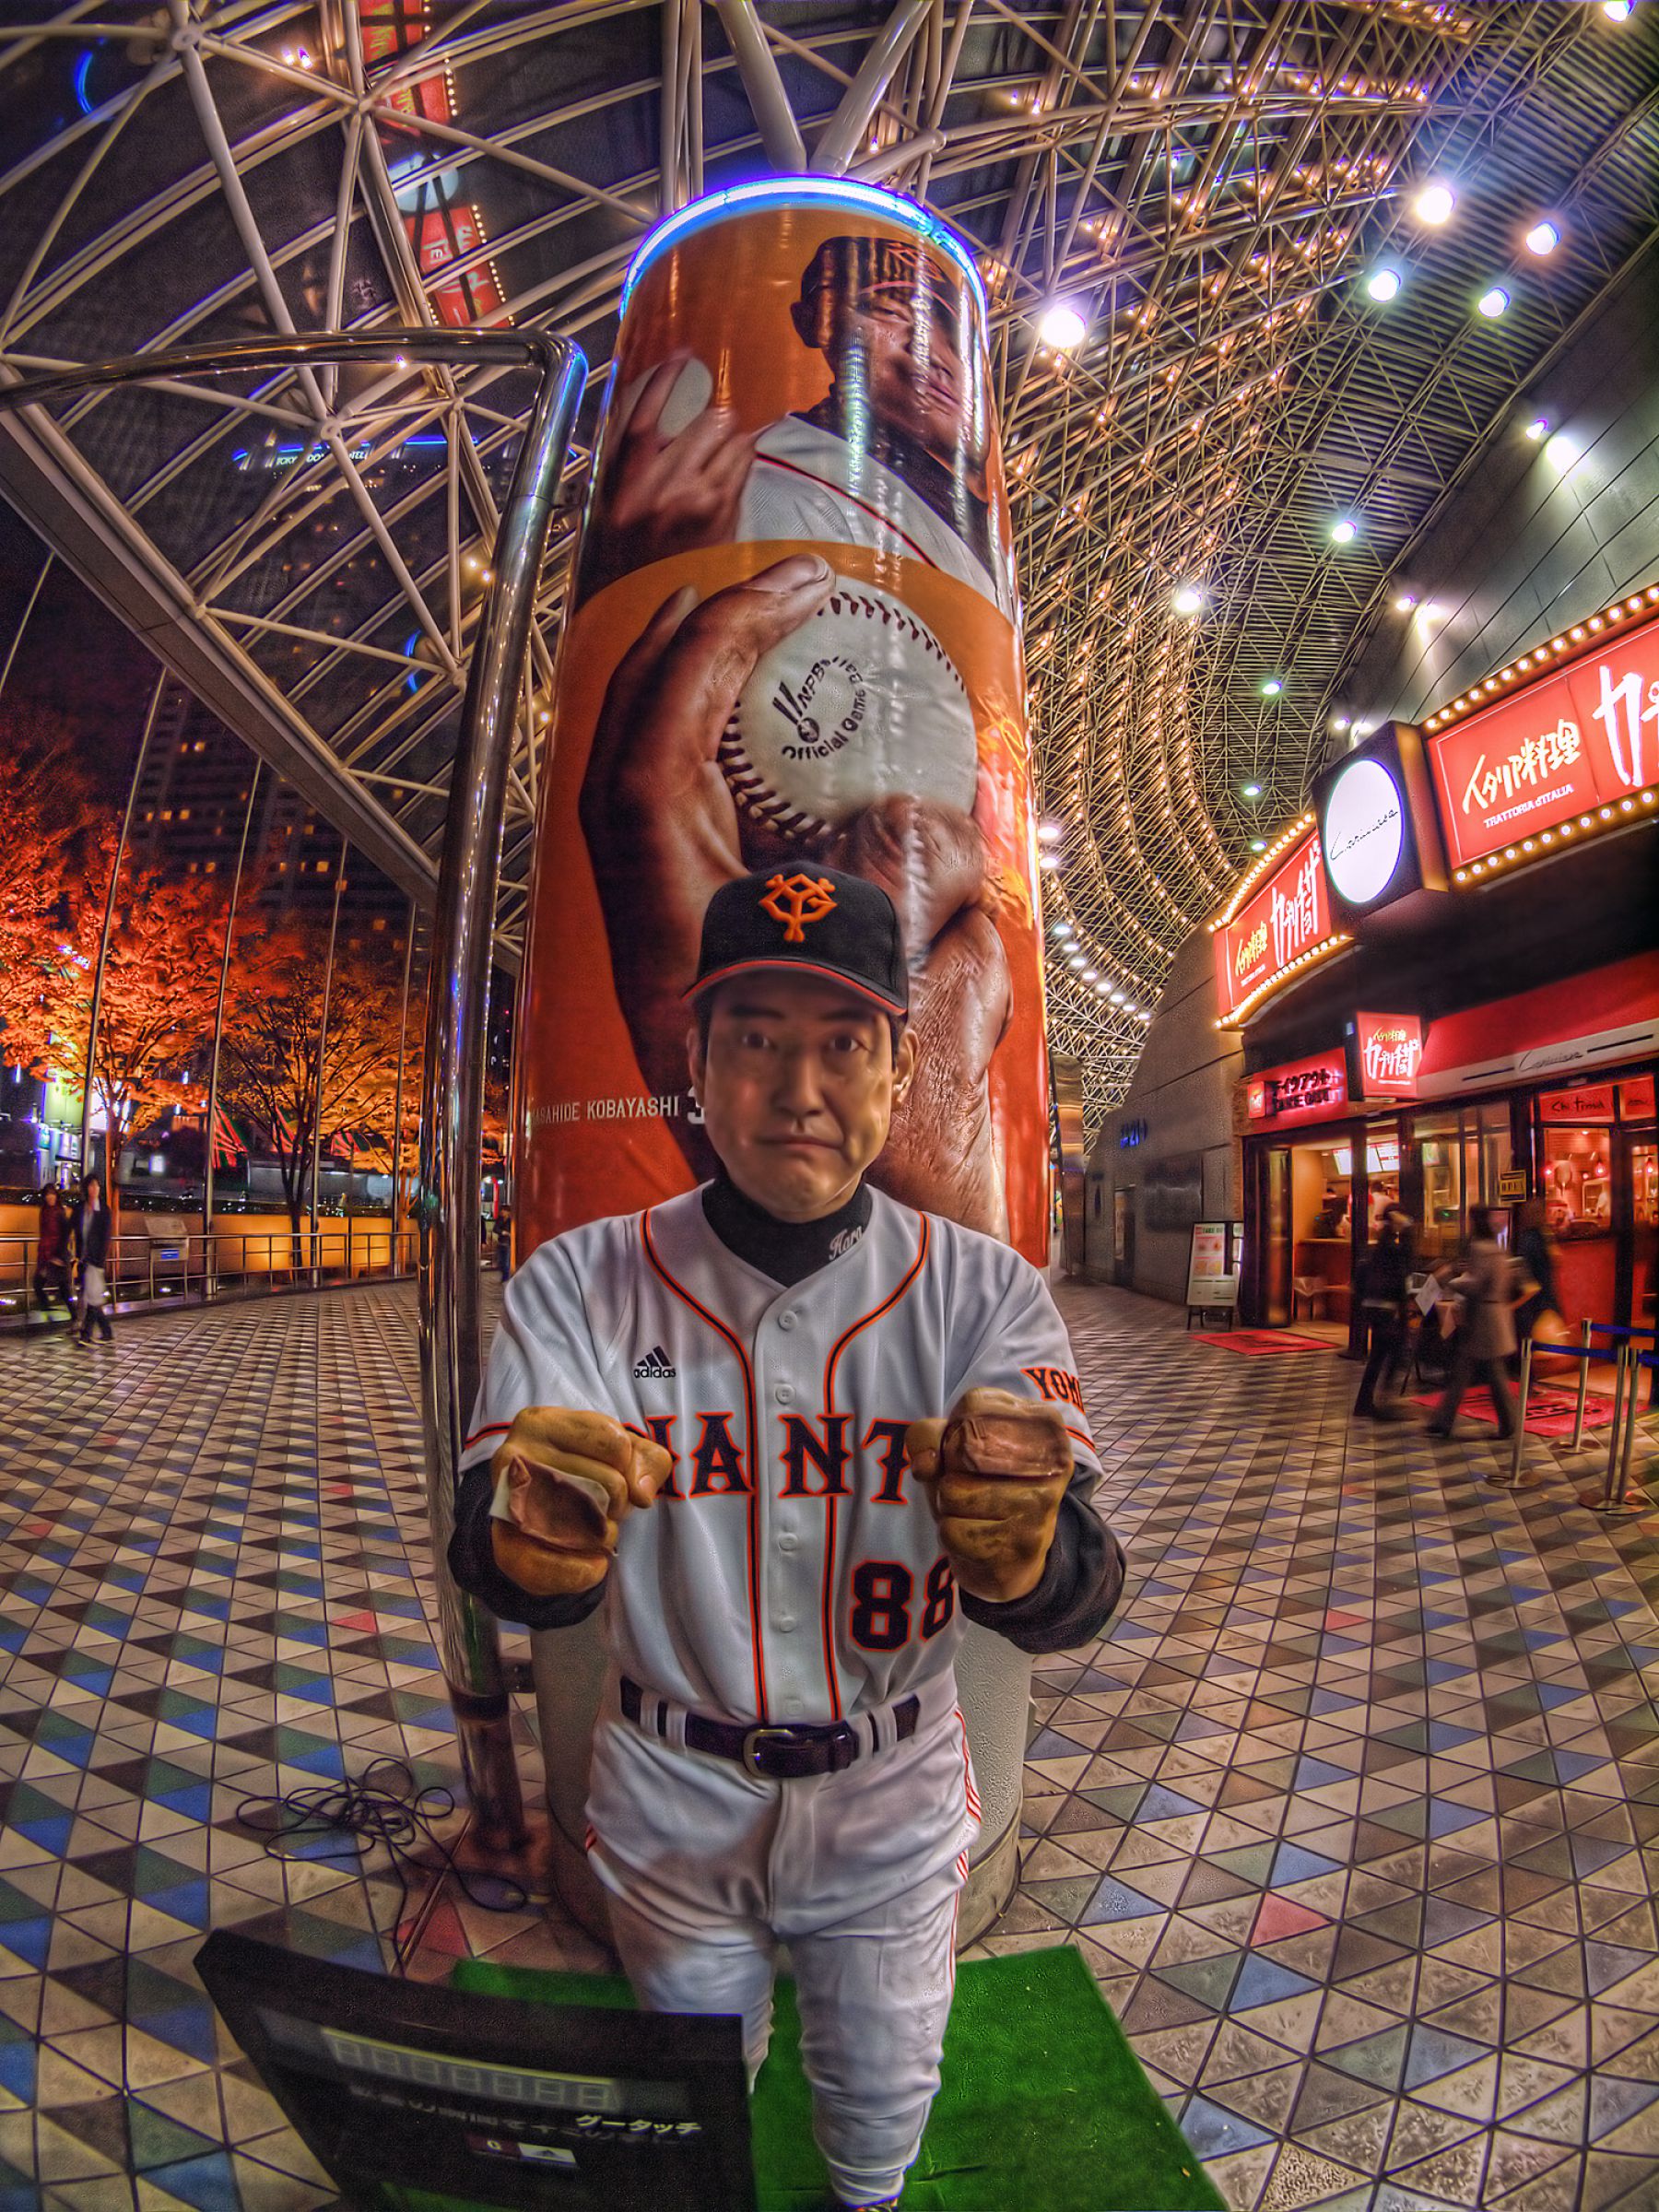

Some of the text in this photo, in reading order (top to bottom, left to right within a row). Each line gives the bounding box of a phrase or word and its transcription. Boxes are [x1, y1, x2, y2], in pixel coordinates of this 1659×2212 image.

[782, 730, 849, 760] Official
[841, 688, 866, 732] Game
[1483, 799, 1535, 828] TRATTORIA
[587, 1095, 680, 1121] KOBAYASHI
[830, 1225, 864, 1262] Hara
[634, 1364, 677, 1379] adidas
[1019, 1366, 1086, 1417] YOM
[621, 1411, 912, 1505] IANT
[851, 1558, 955, 1653] 88
[575, 2113, 702, 2136] グータッチ
